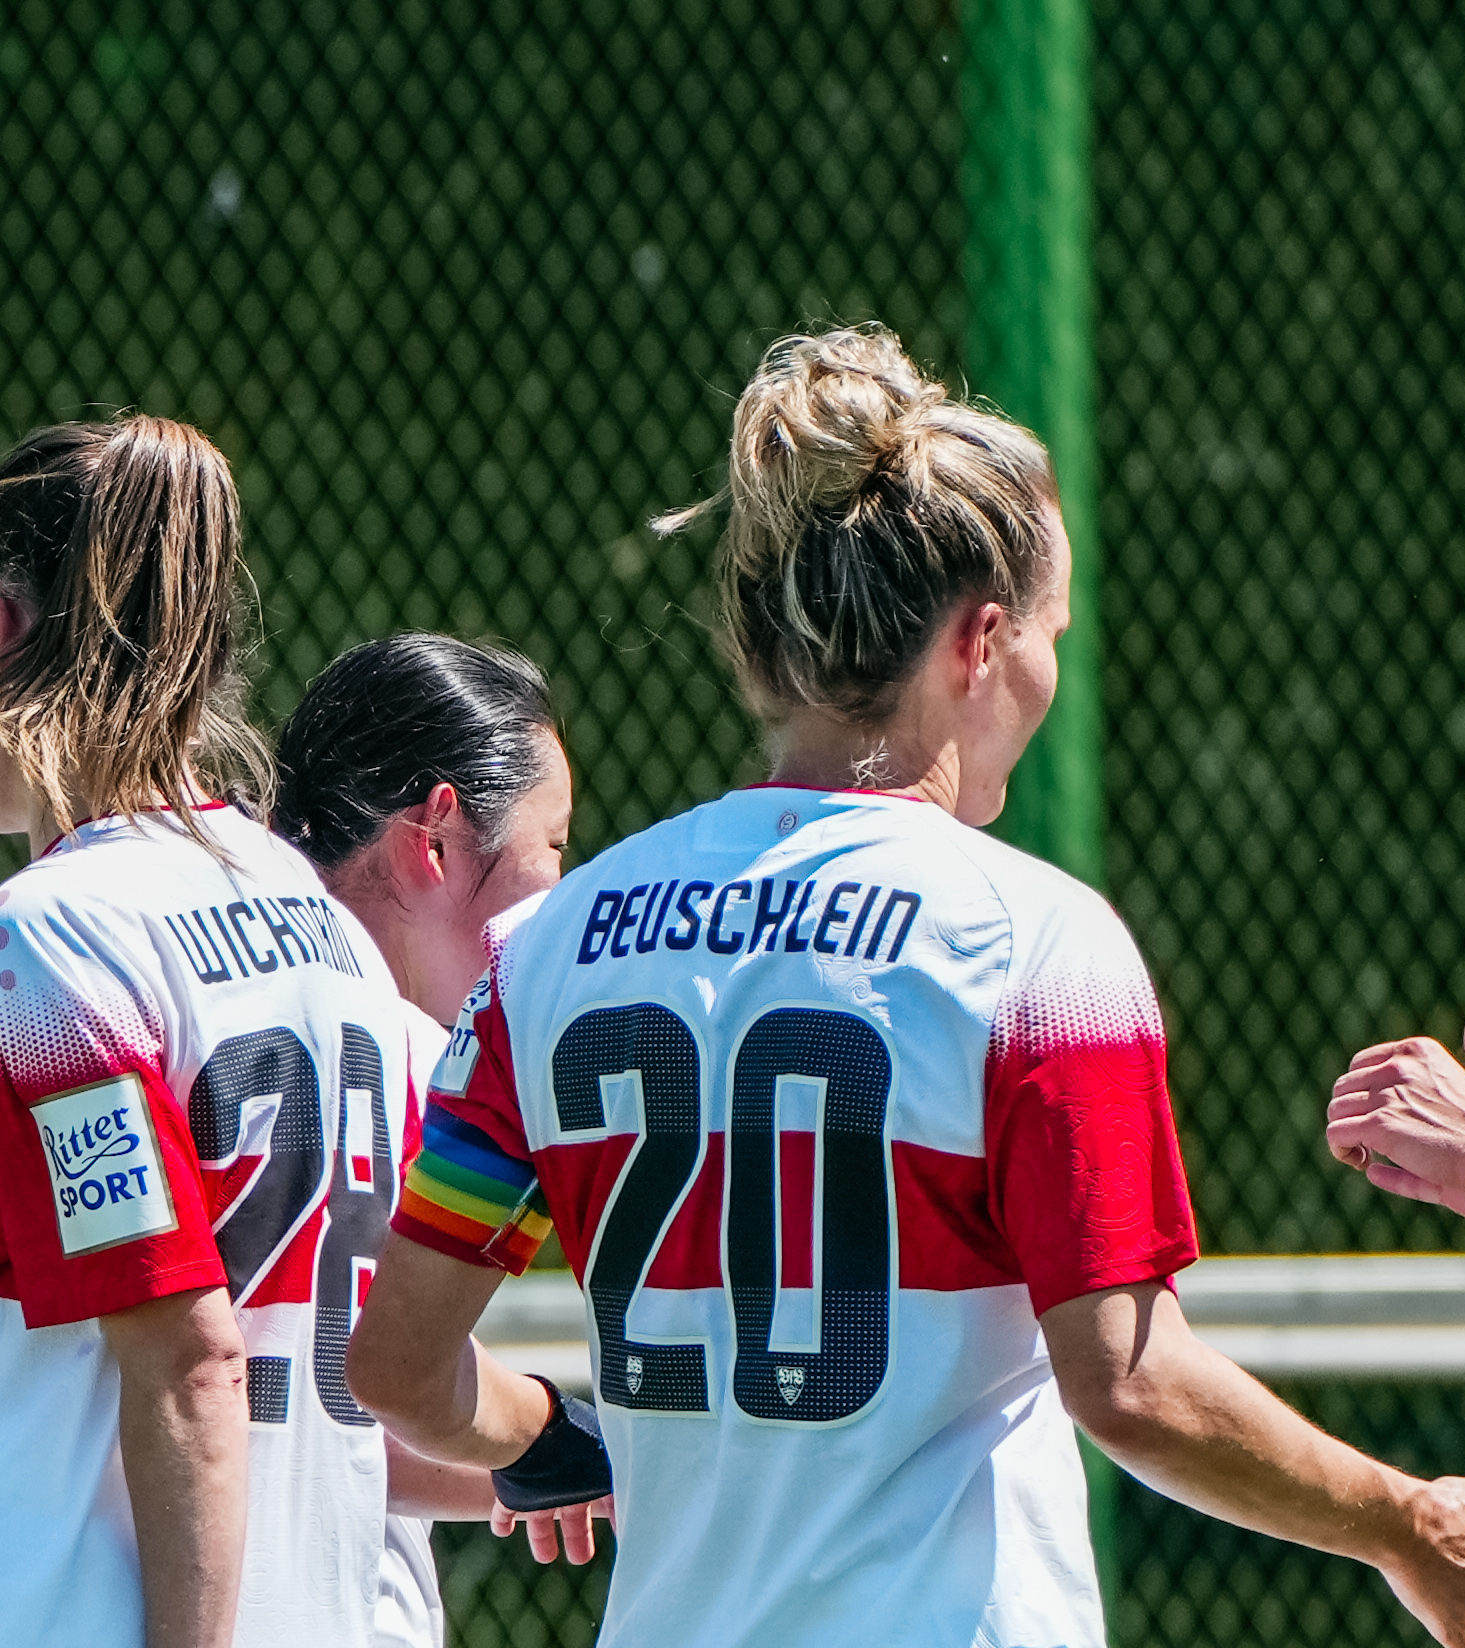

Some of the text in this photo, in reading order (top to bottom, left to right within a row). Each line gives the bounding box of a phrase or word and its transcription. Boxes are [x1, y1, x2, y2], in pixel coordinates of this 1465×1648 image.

[576, 878, 921, 965] BEUSCHLEIN
[43, 1106, 140, 1181] Ritter
[59, 1164, 149, 1218] SPORT
[187, 1022, 398, 1428] 28
[551, 1000, 895, 1425] 20
